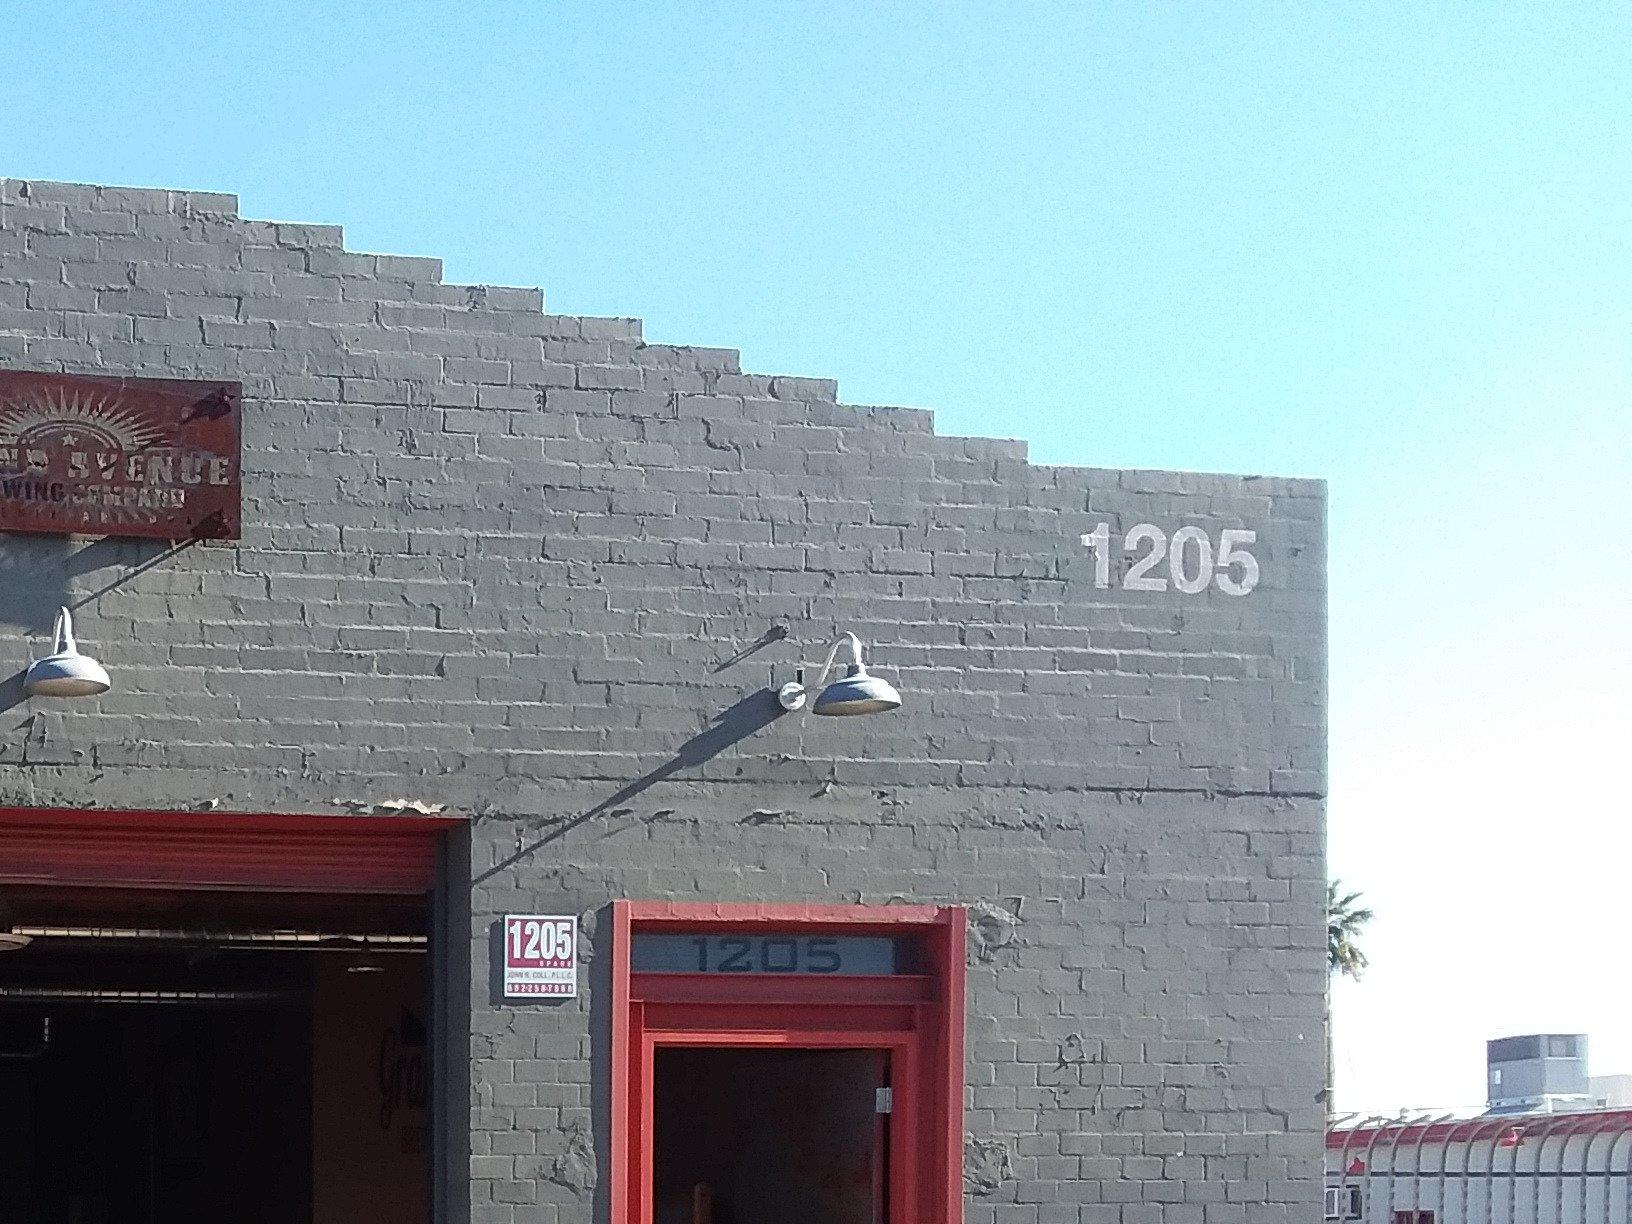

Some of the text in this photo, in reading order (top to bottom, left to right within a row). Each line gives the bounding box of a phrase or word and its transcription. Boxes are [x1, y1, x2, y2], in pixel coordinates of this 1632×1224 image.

[68, 451, 230, 486] AVENUE
[1080, 522, 1260, 596] 1205
[509, 920, 572, 960] 1205
[689, 935, 843, 973] 1205
